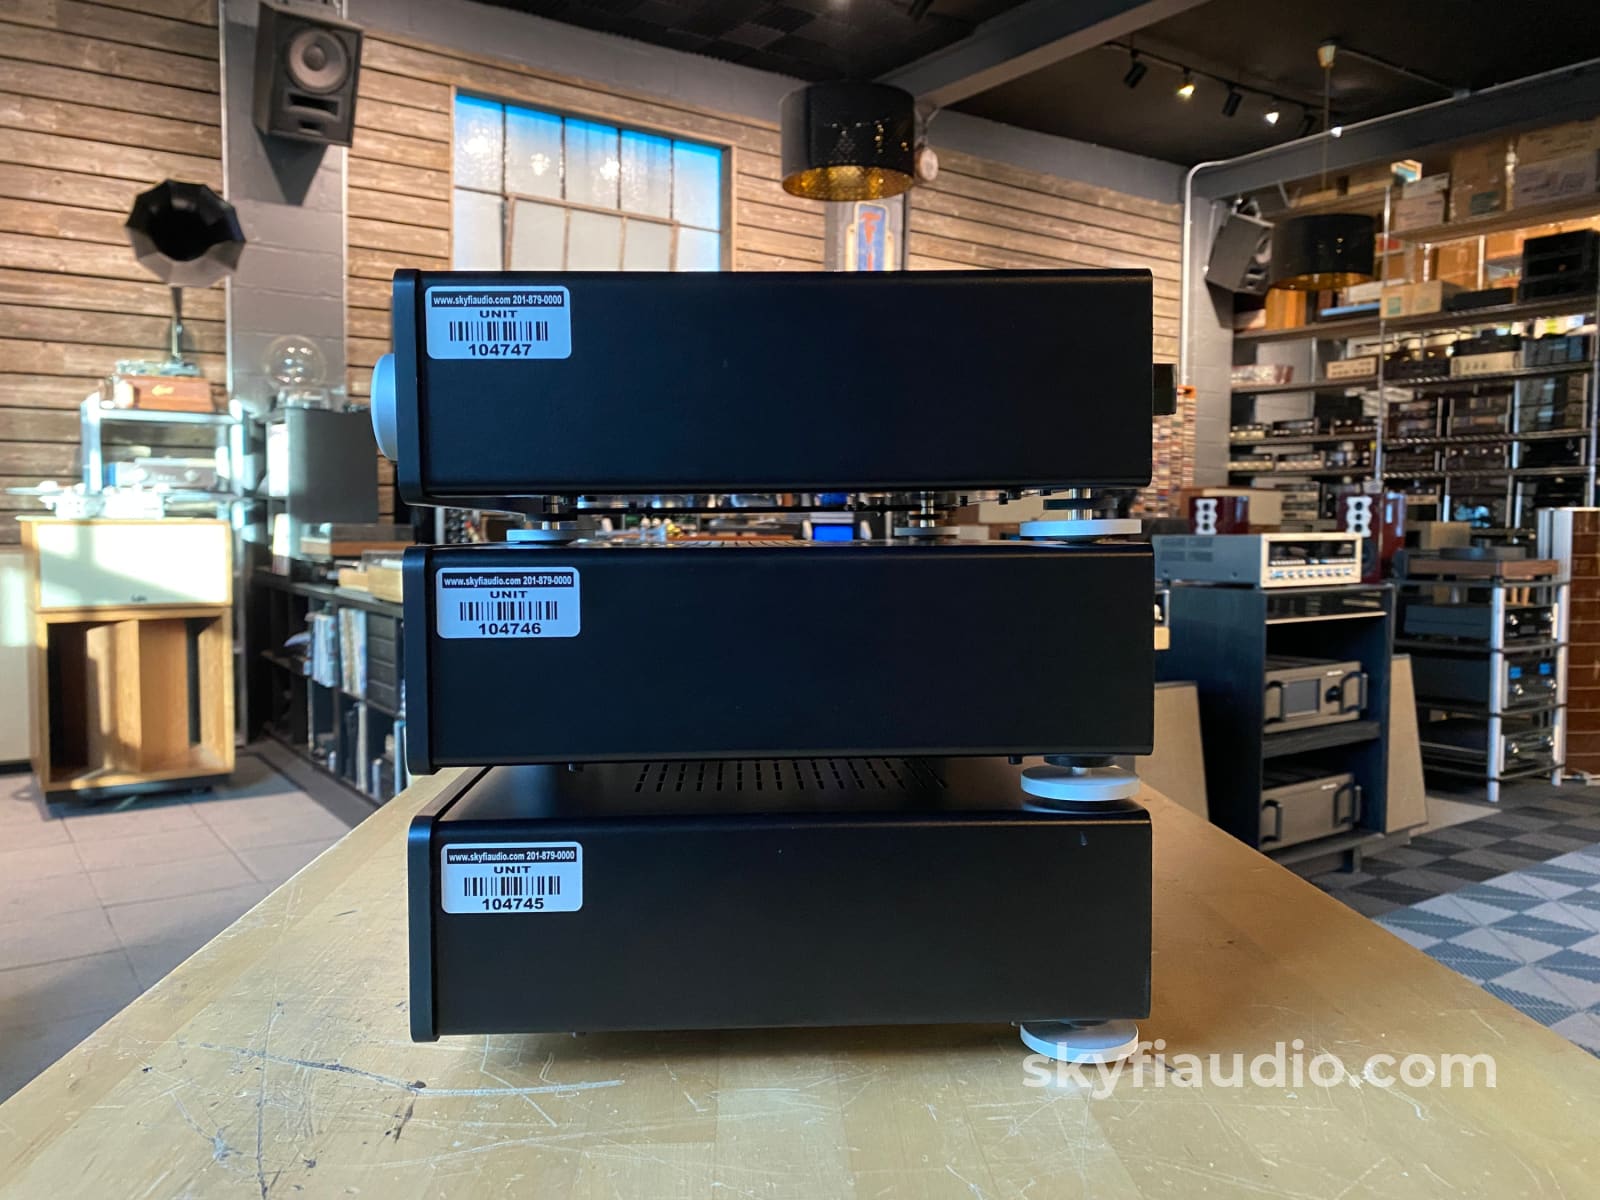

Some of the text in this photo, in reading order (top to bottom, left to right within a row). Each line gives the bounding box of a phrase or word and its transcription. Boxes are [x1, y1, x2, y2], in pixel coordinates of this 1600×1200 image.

[433, 294, 562, 306] www.skyfiaudio.com 201-879-0000
[479, 310, 518, 318] UNIT
[468, 343, 532, 356] 104747
[444, 575, 572, 587] www.skyfiaudio.com 201-879-0000
[490, 590, 528, 598] UNIT
[478, 622, 542, 635] 104746
[449, 850, 575, 863] www.skyfiaudio.com 201-879-0000
[493, 866, 531, 874] UNIT
[482, 898, 544, 910] 104745
